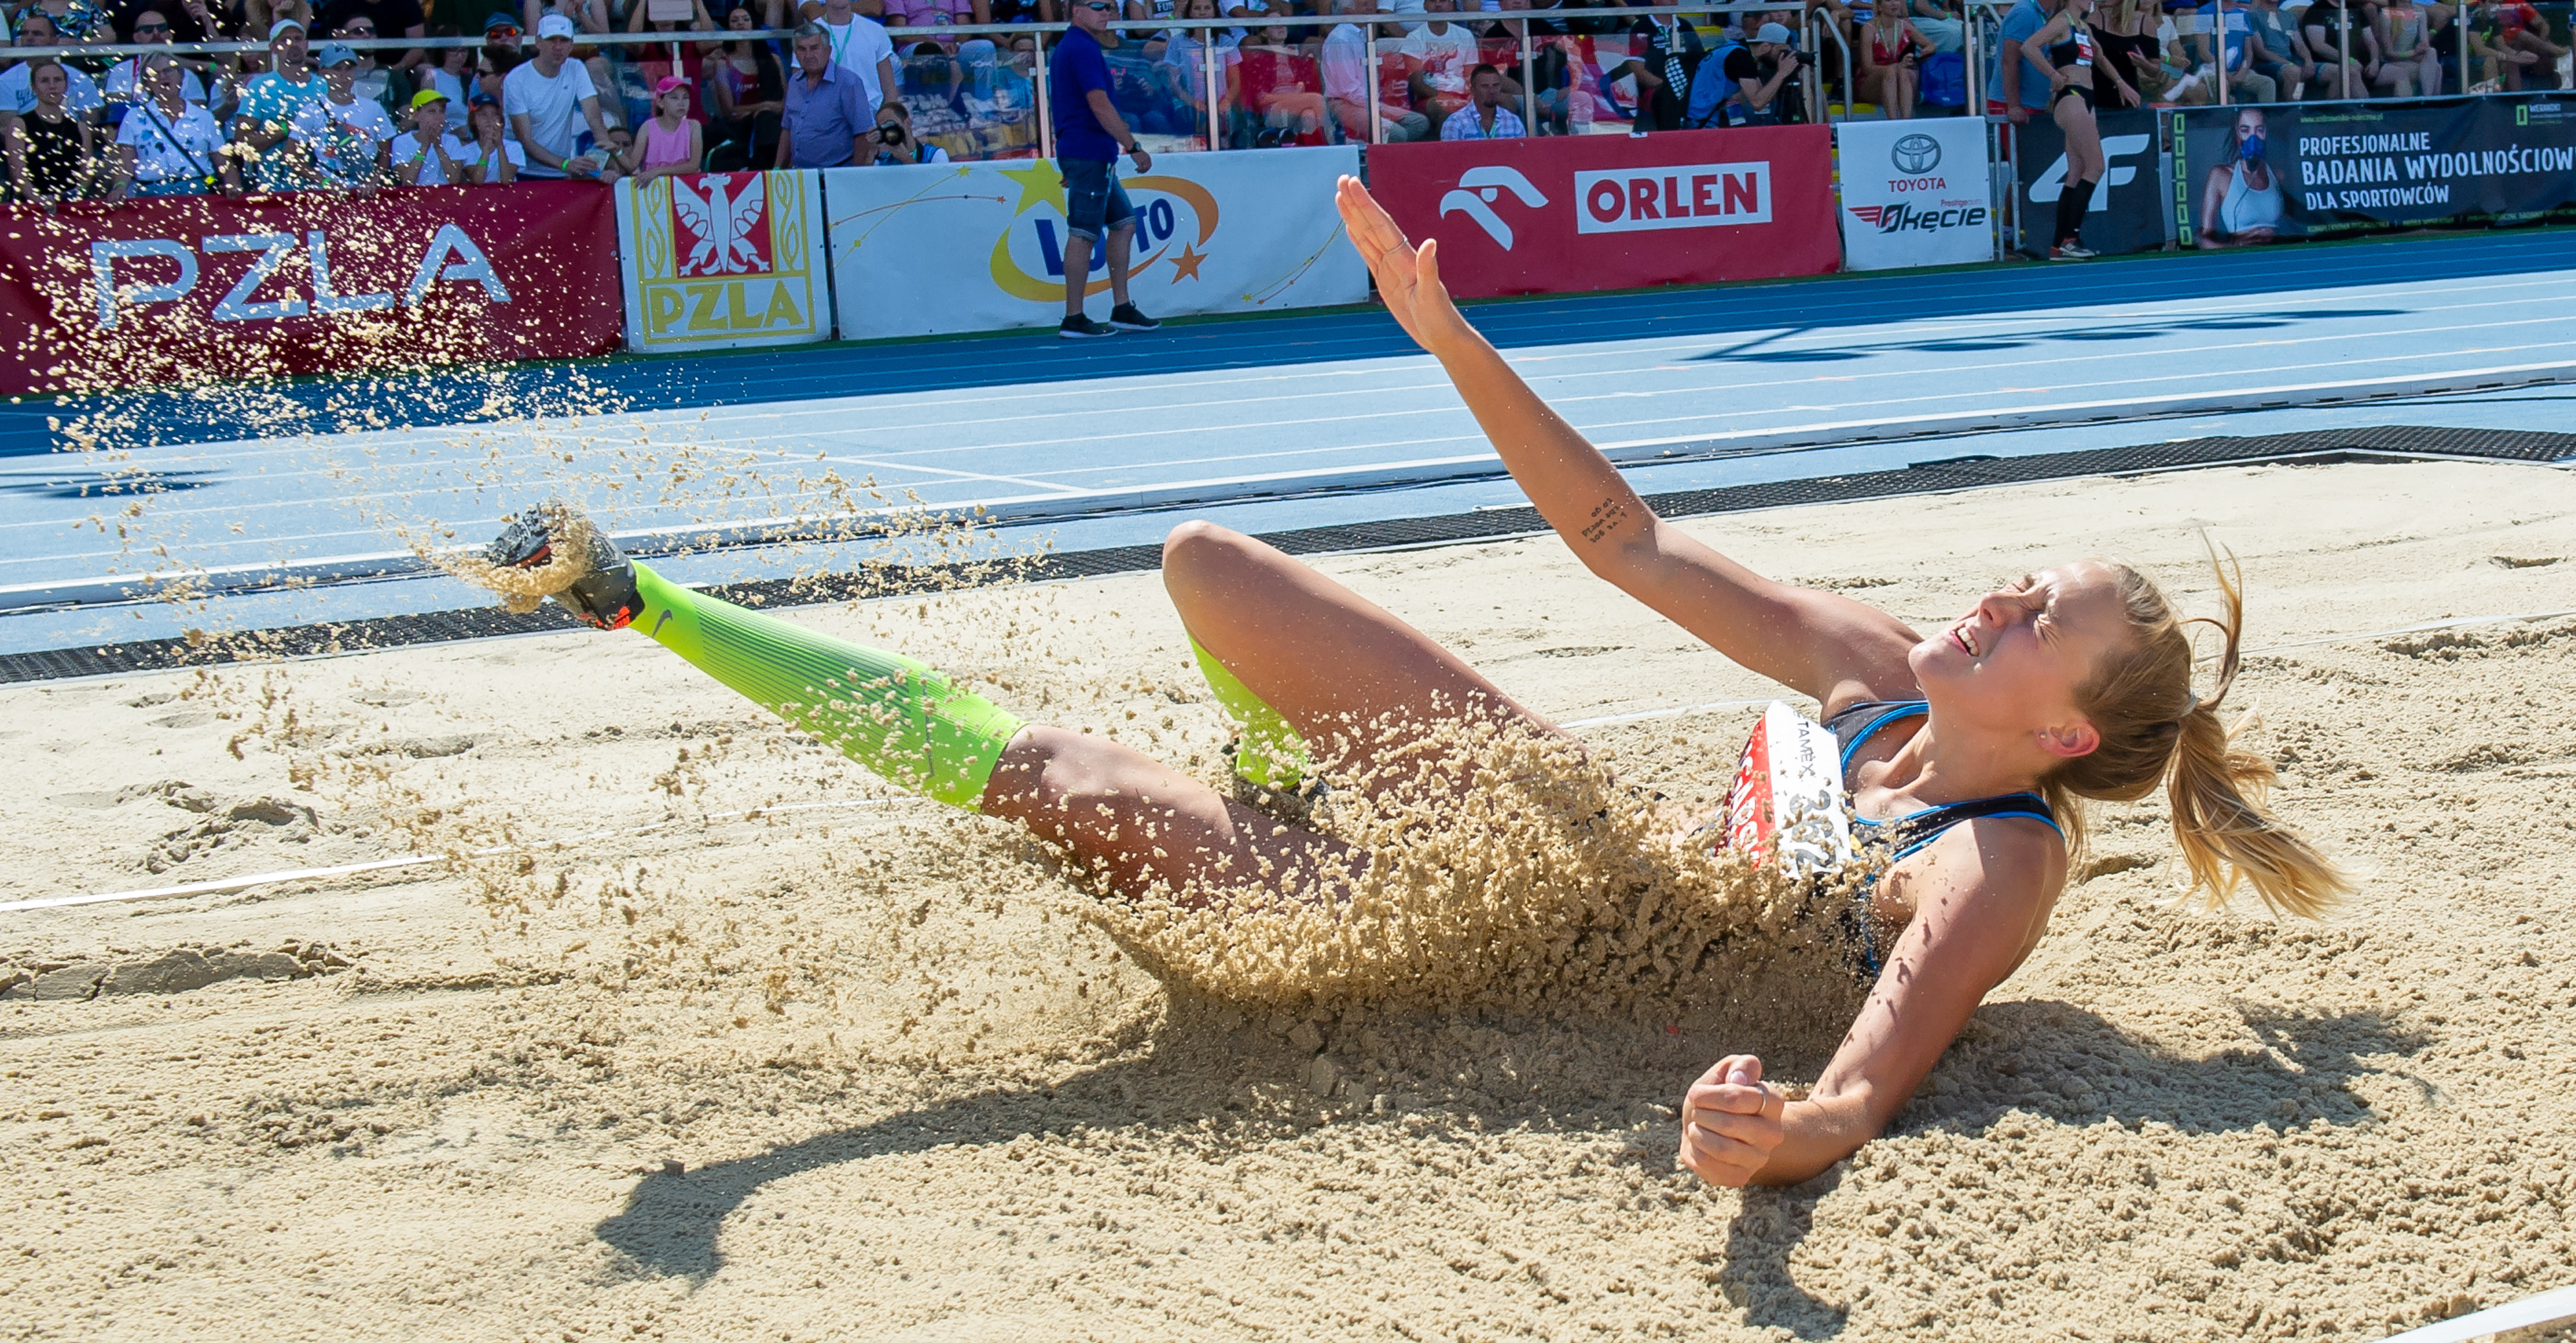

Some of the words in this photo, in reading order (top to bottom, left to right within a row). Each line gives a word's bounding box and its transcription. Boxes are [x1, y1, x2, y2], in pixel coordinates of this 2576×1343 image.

[2299, 132, 2431, 157] PROFESJONALNE
[2302, 157, 2398, 185] BADANIA
[2404, 143, 2576, 180] WYDOLNOŚCIOW
[1587, 172, 1759, 224] ORLEN
[1887, 177, 1947, 193] TOYOTA
[2305, 191, 2339, 210] DLA
[2339, 181, 2450, 208] SPORTOWCÓW
[90, 223, 512, 330] PZLA
[649, 280, 805, 334] PZLA
